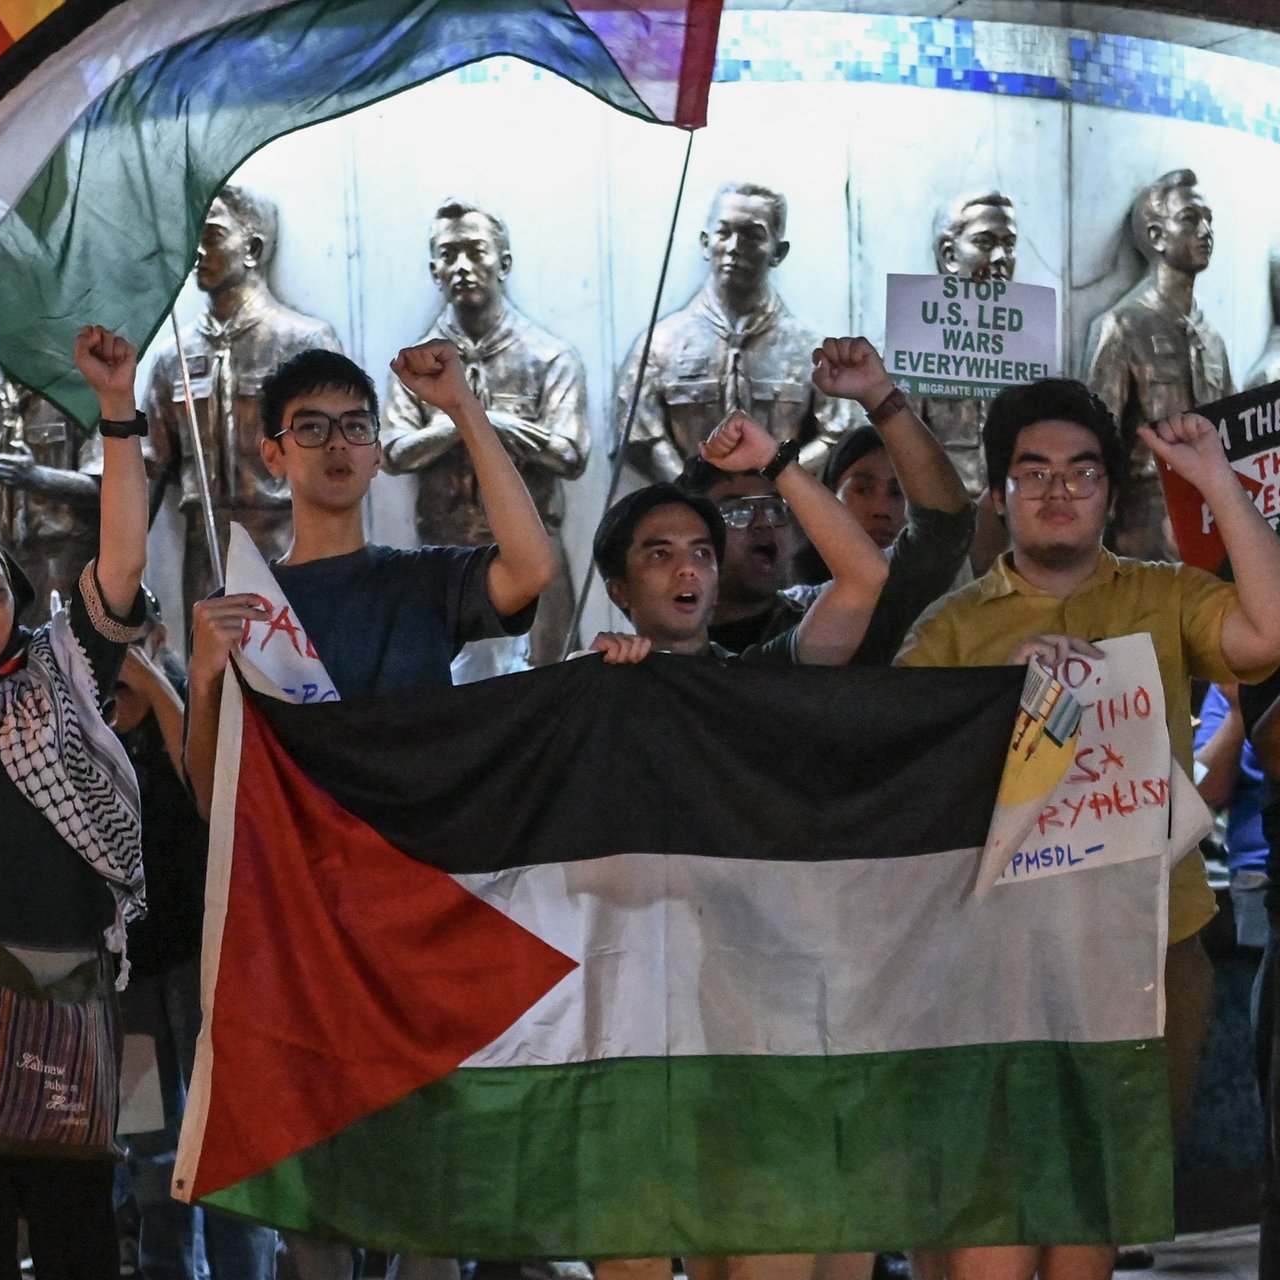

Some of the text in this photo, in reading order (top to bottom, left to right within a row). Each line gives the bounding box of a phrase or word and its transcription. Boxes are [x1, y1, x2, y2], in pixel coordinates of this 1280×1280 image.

[943, 276, 1006, 302] STOP
[921, 302, 1024, 332] U.S. LED
[942, 329, 1004, 355] WARS
[894, 351, 1048, 382] EVERYWHERE!
[918, 382, 971, 396] MIGRANTE
